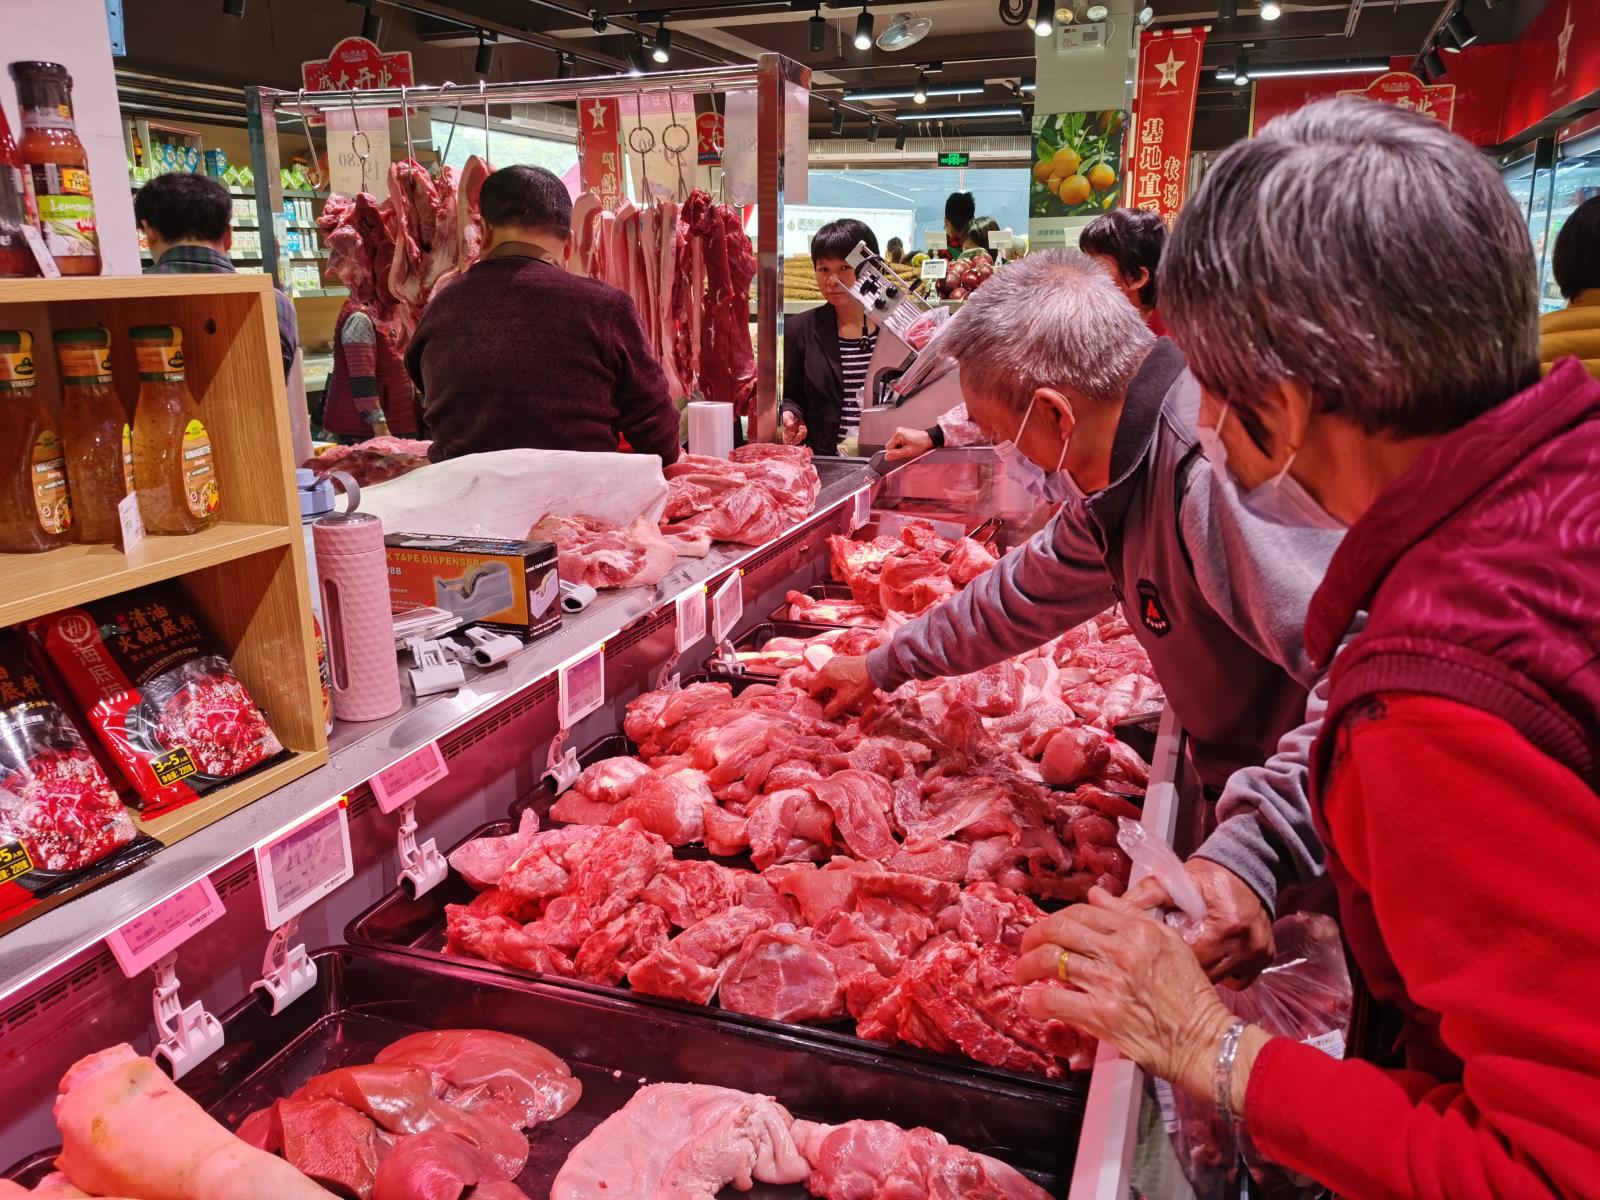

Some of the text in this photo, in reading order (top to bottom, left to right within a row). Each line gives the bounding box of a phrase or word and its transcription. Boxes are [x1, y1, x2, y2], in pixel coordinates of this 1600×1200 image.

[394, 552, 421, 563] TAPE
[422, 555, 481, 568] DISPENSER
[129, 602, 169, 629] 清油
[118, 614, 198, 653] 火锅底料
